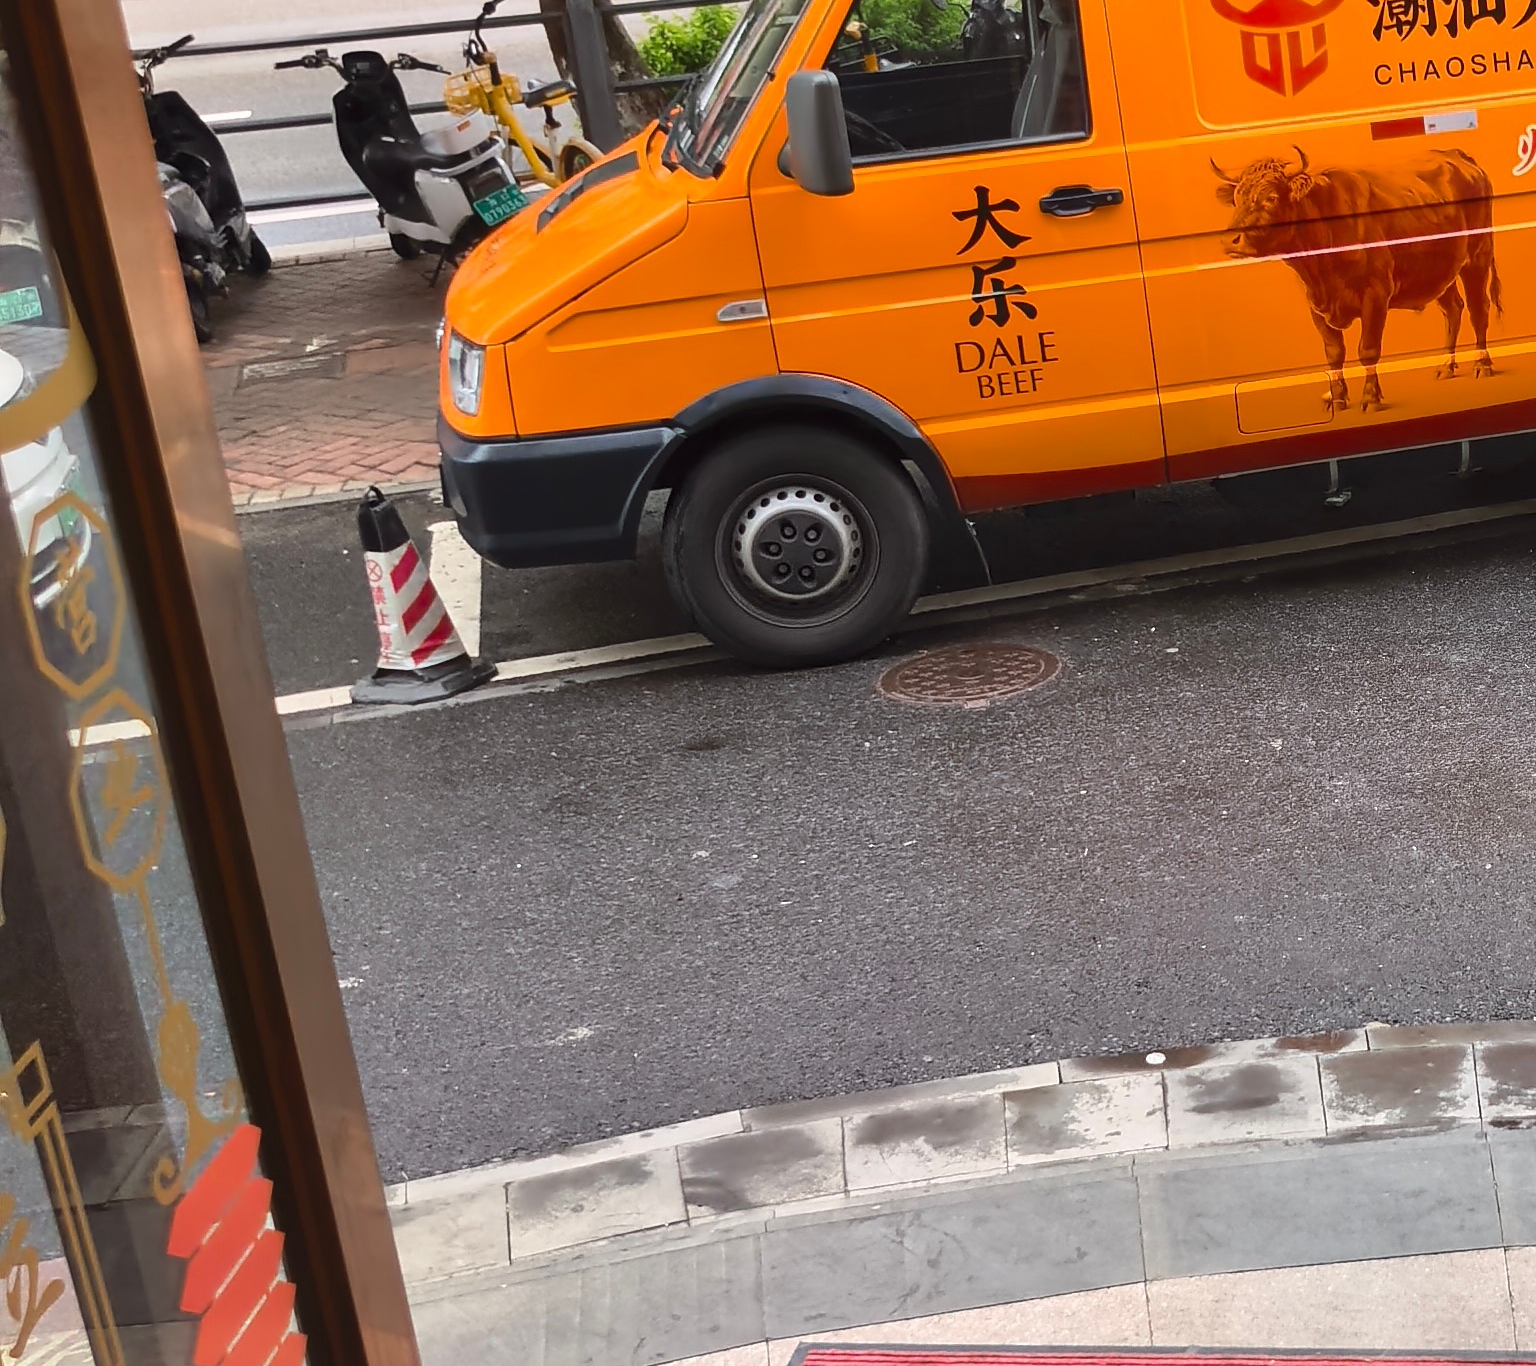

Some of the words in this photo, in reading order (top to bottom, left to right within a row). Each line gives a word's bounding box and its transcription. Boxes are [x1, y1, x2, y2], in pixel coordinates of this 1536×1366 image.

[951, 185, 1038, 328] 大乐
[954, 331, 1059, 374] DALE
[977, 368, 1044, 399] BEEF
